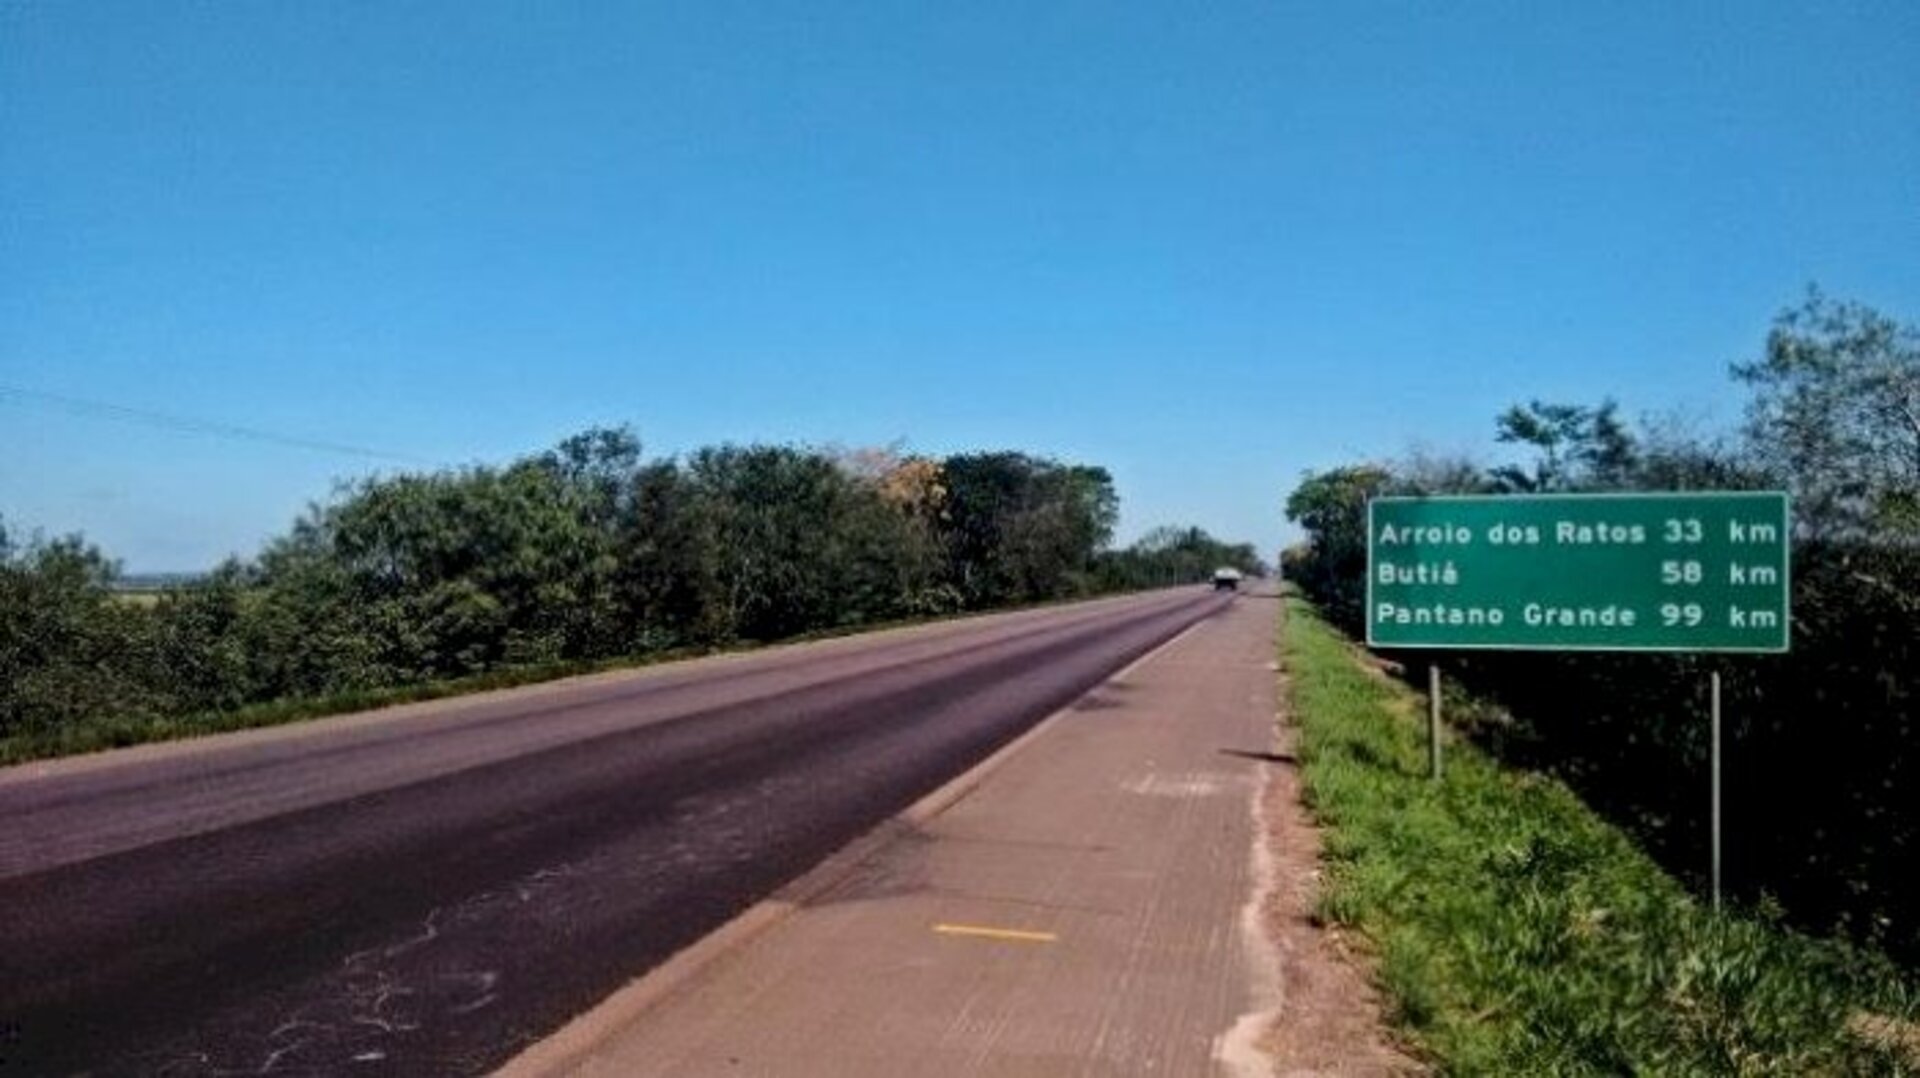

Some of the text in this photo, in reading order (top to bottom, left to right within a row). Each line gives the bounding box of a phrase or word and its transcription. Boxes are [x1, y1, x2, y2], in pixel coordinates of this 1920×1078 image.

[1379, 519, 1777, 544] Arroio dos Ratos 33 km
[1377, 561, 1777, 585] Butiá 58 km
[1376, 603, 1777, 628] Pantano Grande 99 km
